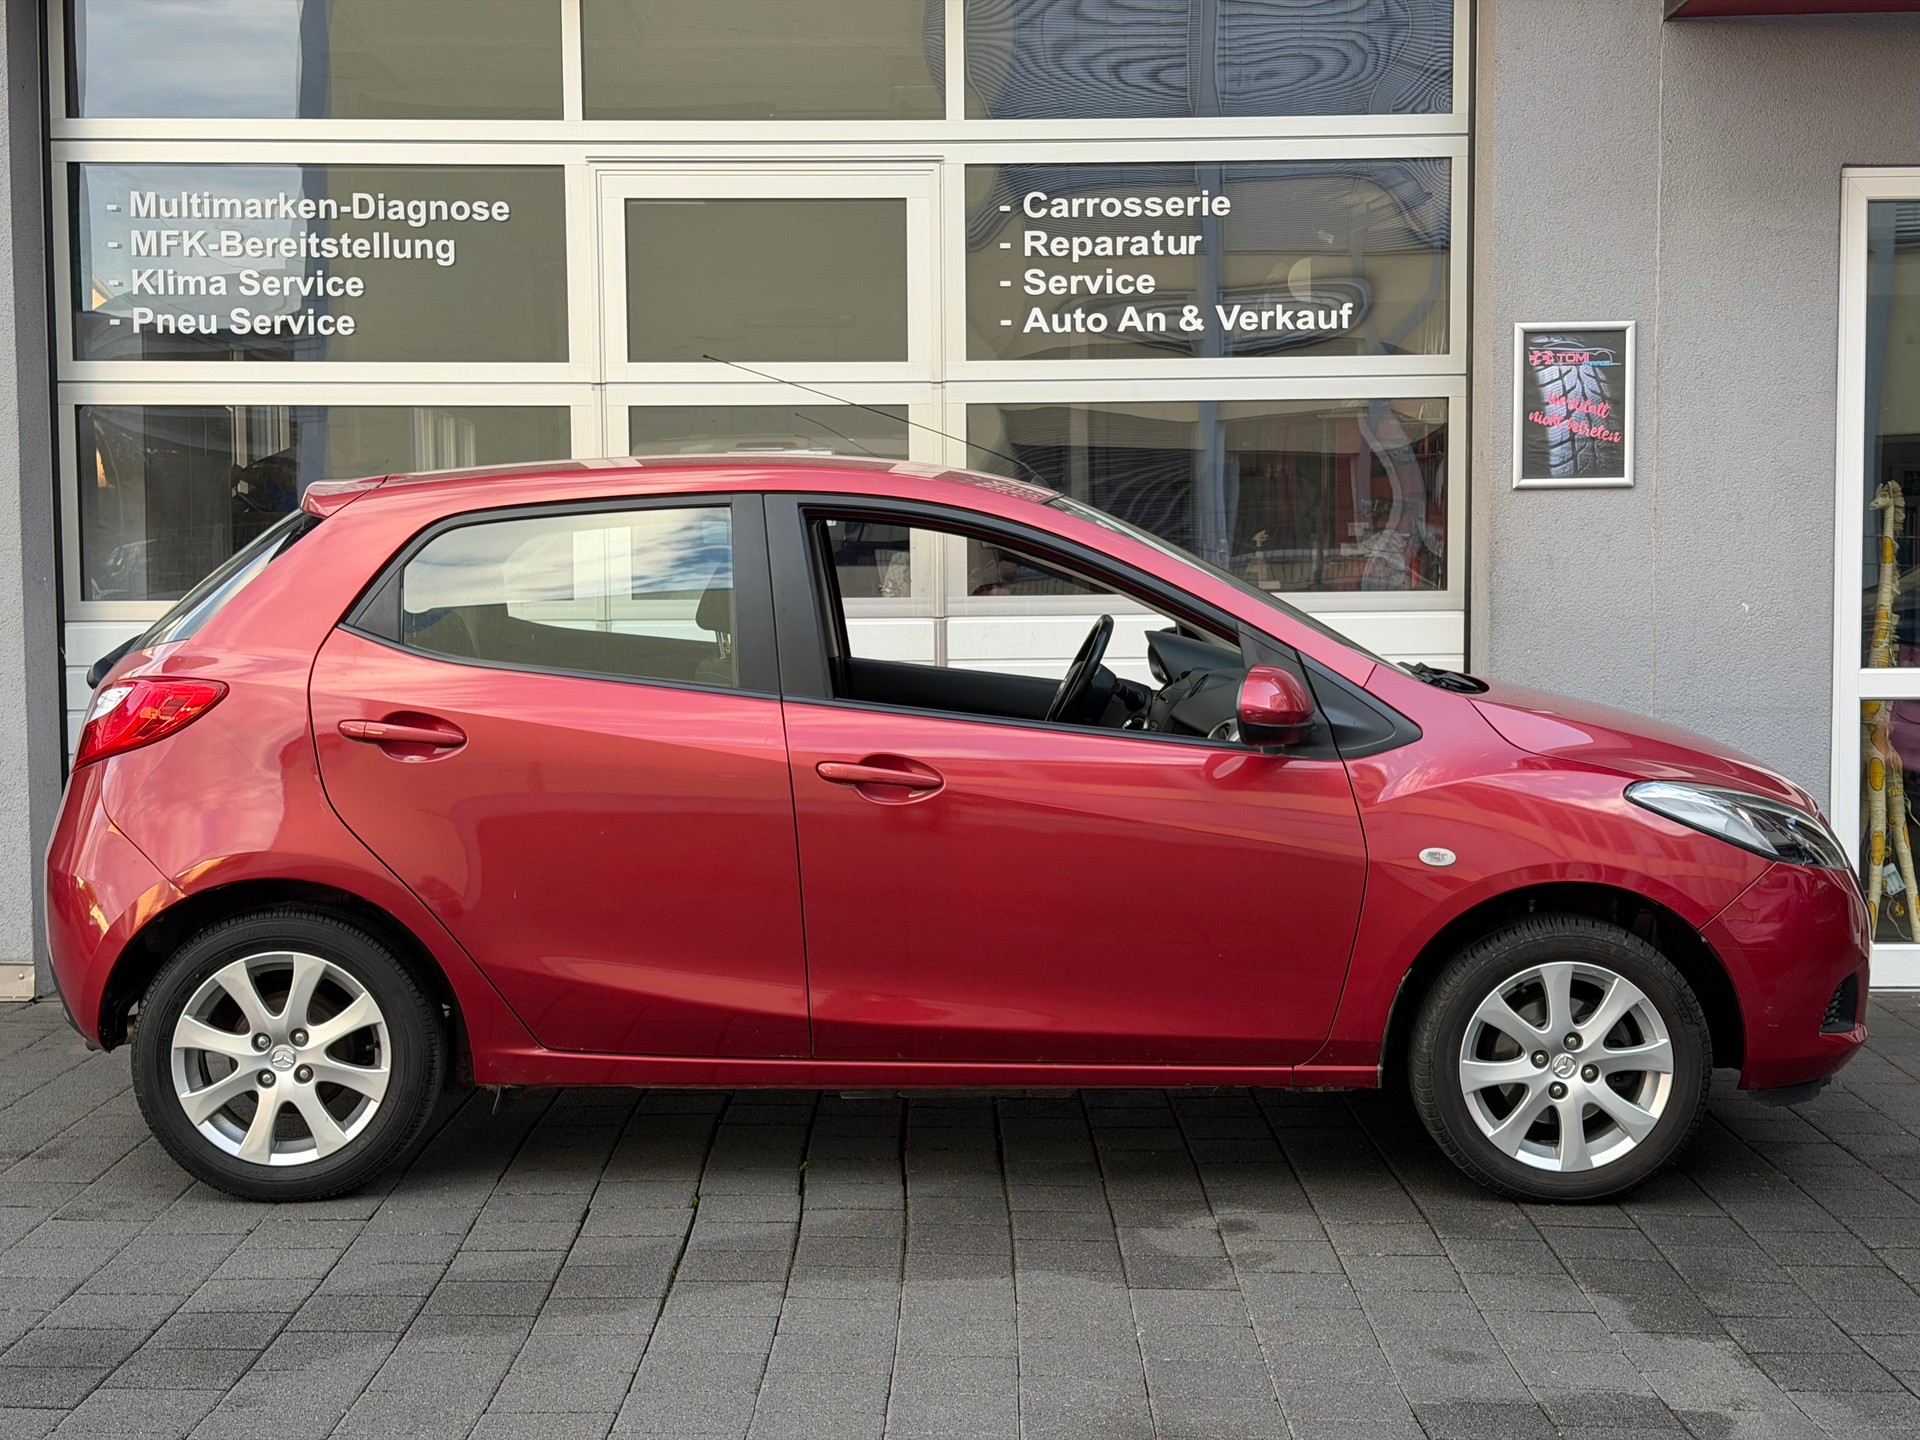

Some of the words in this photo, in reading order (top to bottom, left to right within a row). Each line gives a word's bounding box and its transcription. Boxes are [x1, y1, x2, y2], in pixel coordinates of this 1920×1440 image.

[130, 191, 510, 227] Multimarken-Diagnose
[1023, 190, 1231, 218] Carrosserie
[130, 230, 455, 266] MFK-Bereitstellung
[1024, 230, 1203, 263] Reparatur
[131, 269, 227, 296] Klima
[238, 269, 364, 297] Service
[1023, 268, 1156, 295] Service
[132, 307, 217, 334] Pneu
[229, 307, 355, 335] Service
[1023, 307, 1108, 333] Auto
[1117, 306, 1166, 332] An
[1179, 305, 1205, 332] &
[1215, 302, 1354, 331] Verkauf
[1556, 352, 1590, 363] TOMI
[1566, 417, 1621, 443] betreten
